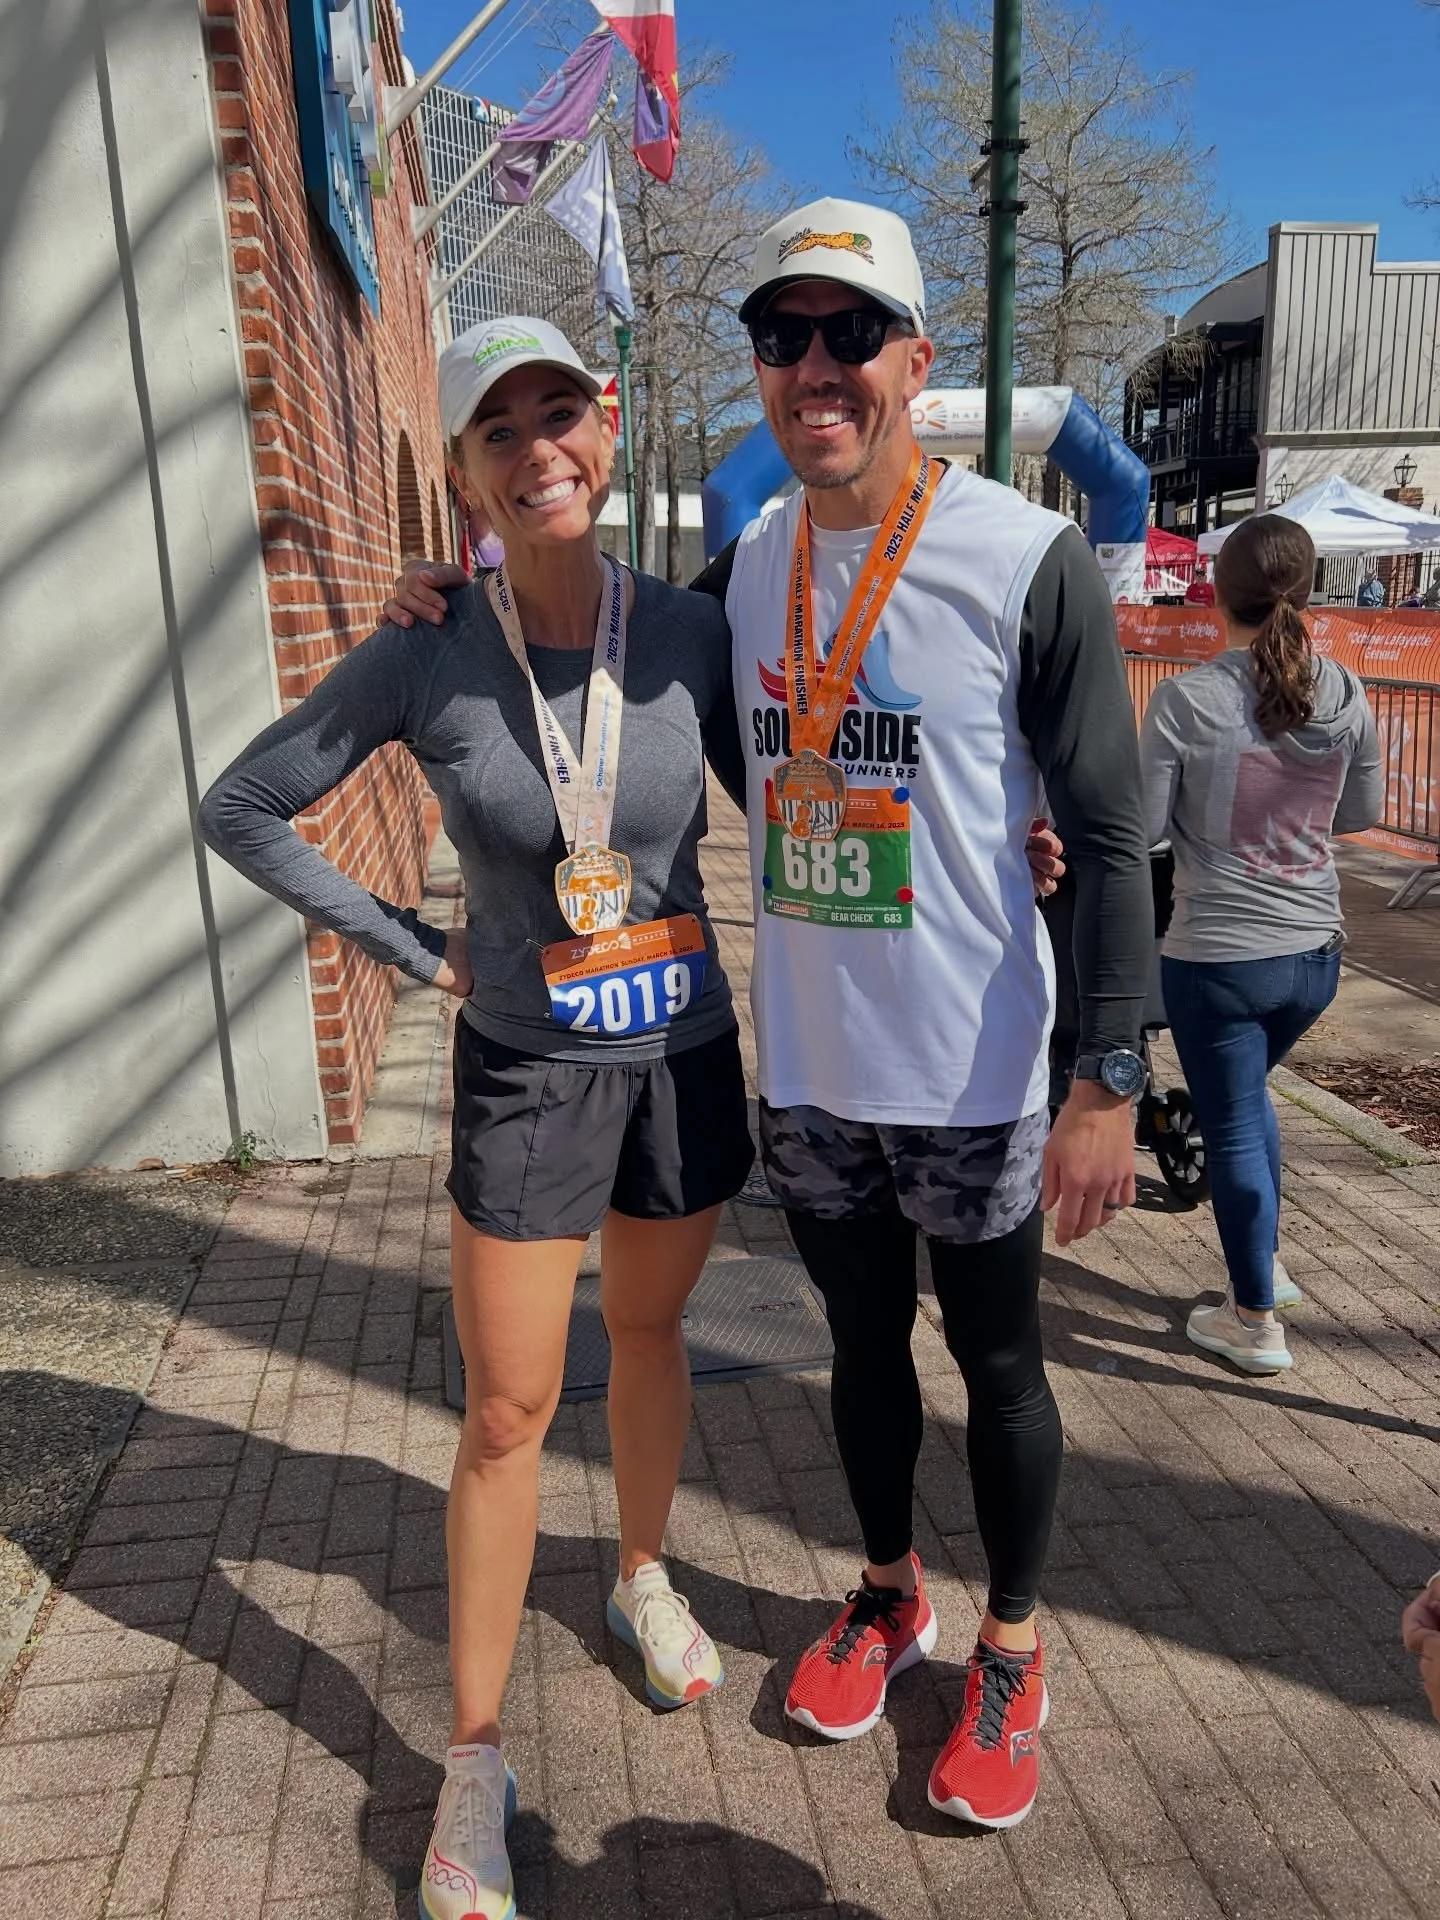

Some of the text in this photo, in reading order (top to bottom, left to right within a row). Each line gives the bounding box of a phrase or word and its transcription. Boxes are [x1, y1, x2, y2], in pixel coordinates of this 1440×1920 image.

[916, 433, 952, 441] Lafayette
[884, 532, 904, 562] 2025
[897, 503, 916, 533] HALF
[499, 588, 511, 613] 2025
[609, 580, 621, 636] MARATHON
[793, 604, 804, 661] MARATHON
[837, 647, 852, 676] Ochsner
[864, 576, 881, 606] General
[1351, 632, 1432, 648] Ochsner Lafayette
[607, 636, 619, 663] 2025
[794, 665, 808, 715] FINISHER
[753, 708, 921, 764] SOUSIDE
[548, 735, 570, 784] FINISHER
[596, 758, 605, 787] Ochsner
[838, 764, 917, 778] UNNERS
[852, 822, 875, 830] MARCH
[781, 833, 871, 897] 683
[831, 912, 849, 922] GEAR
[850, 913, 874, 923] CHECK
[883, 914, 902, 924] 683
[559, 970, 584, 980] ZYDECO
[585, 962, 619, 974] MARATHON
[621, 957, 646, 967] SUNDAY,
[647, 951, 668, 960] MARCH
[567, 962, 691, 1034] 2019
